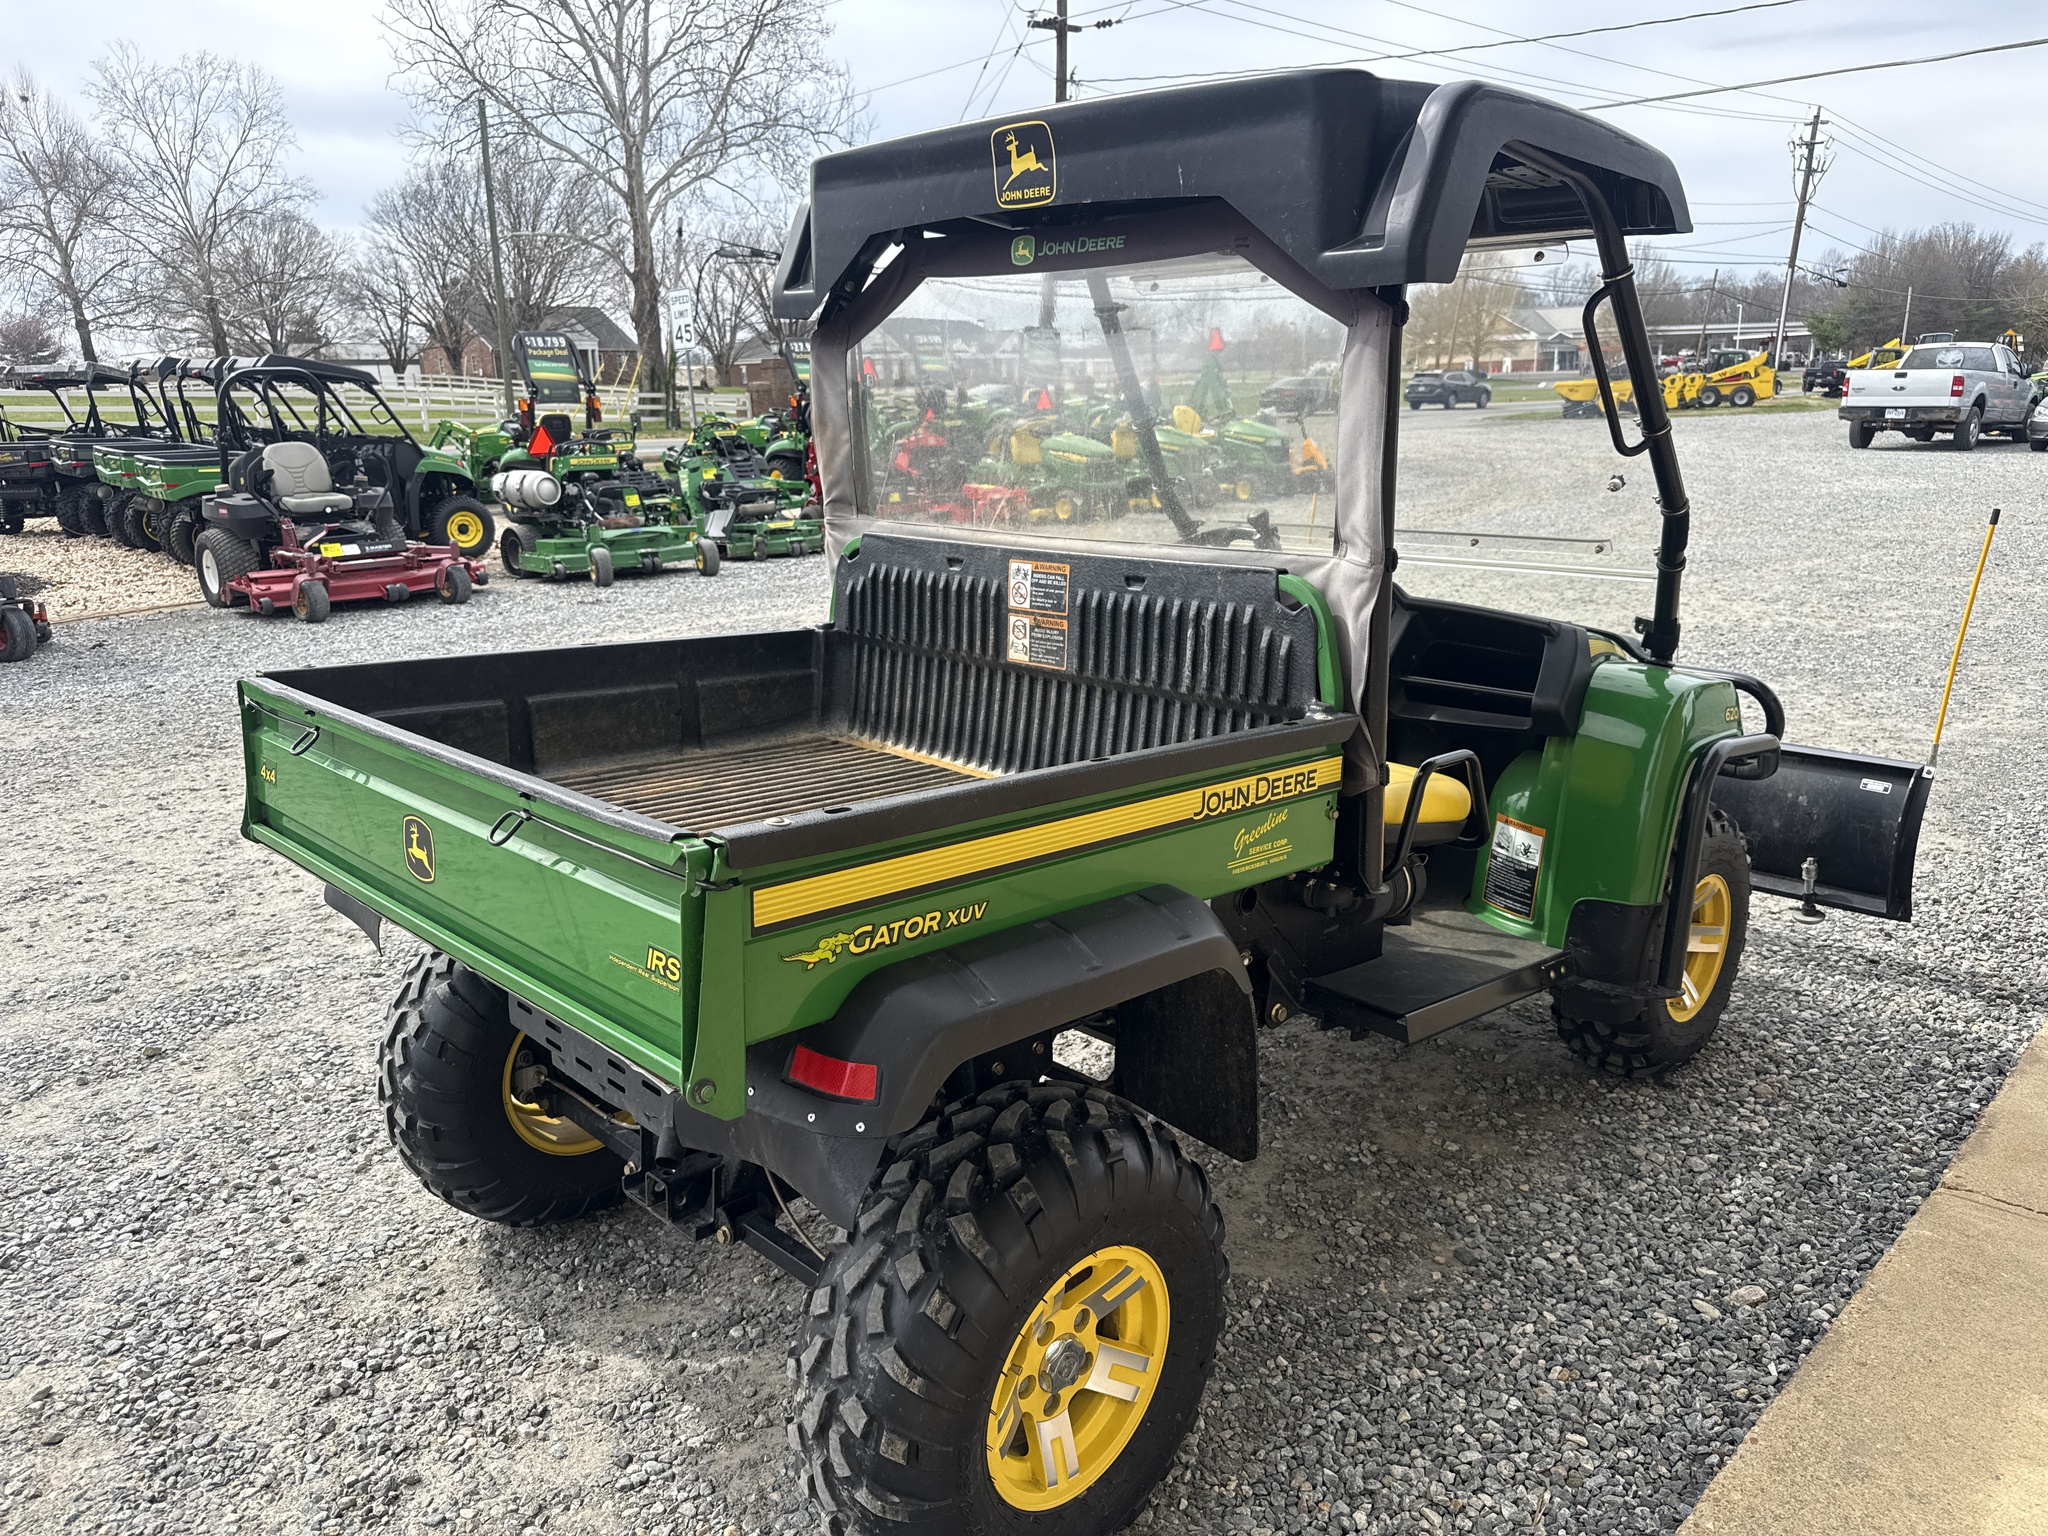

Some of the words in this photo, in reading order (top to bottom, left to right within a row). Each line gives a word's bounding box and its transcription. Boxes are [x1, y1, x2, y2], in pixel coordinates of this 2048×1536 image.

[1000, 190, 1022, 202] JOHN
[1024, 186, 1051, 199] DEERE
[1038, 241, 1076, 257] JOHN
[1077, 235, 1126, 253] DEERE
[671, 295, 689, 305] SPEED
[674, 309, 689, 319] LIMIT
[525, 336, 567, 348] $18,799
[675, 324, 693, 343] 45
[528, 348, 554, 358] Package
[1039, 564, 1067, 573] WARNING
[260, 764, 276, 784] 4x4
[1193, 784, 1251, 818] JOHN
[1255, 768, 1318, 803] DEERE
[1233, 808, 1289, 858] Greenline
[1508, 820, 1533, 832] WARNING
[1249, 842, 1272, 855] SERVICE
[848, 911, 942, 954] GATOR
[944, 901, 988, 928] XUV
[646, 946, 681, 982] IRS
[609, 953, 637, 973] Independent
[638, 968, 650, 979] Rear
[650, 974, 680, 993] Suspension
